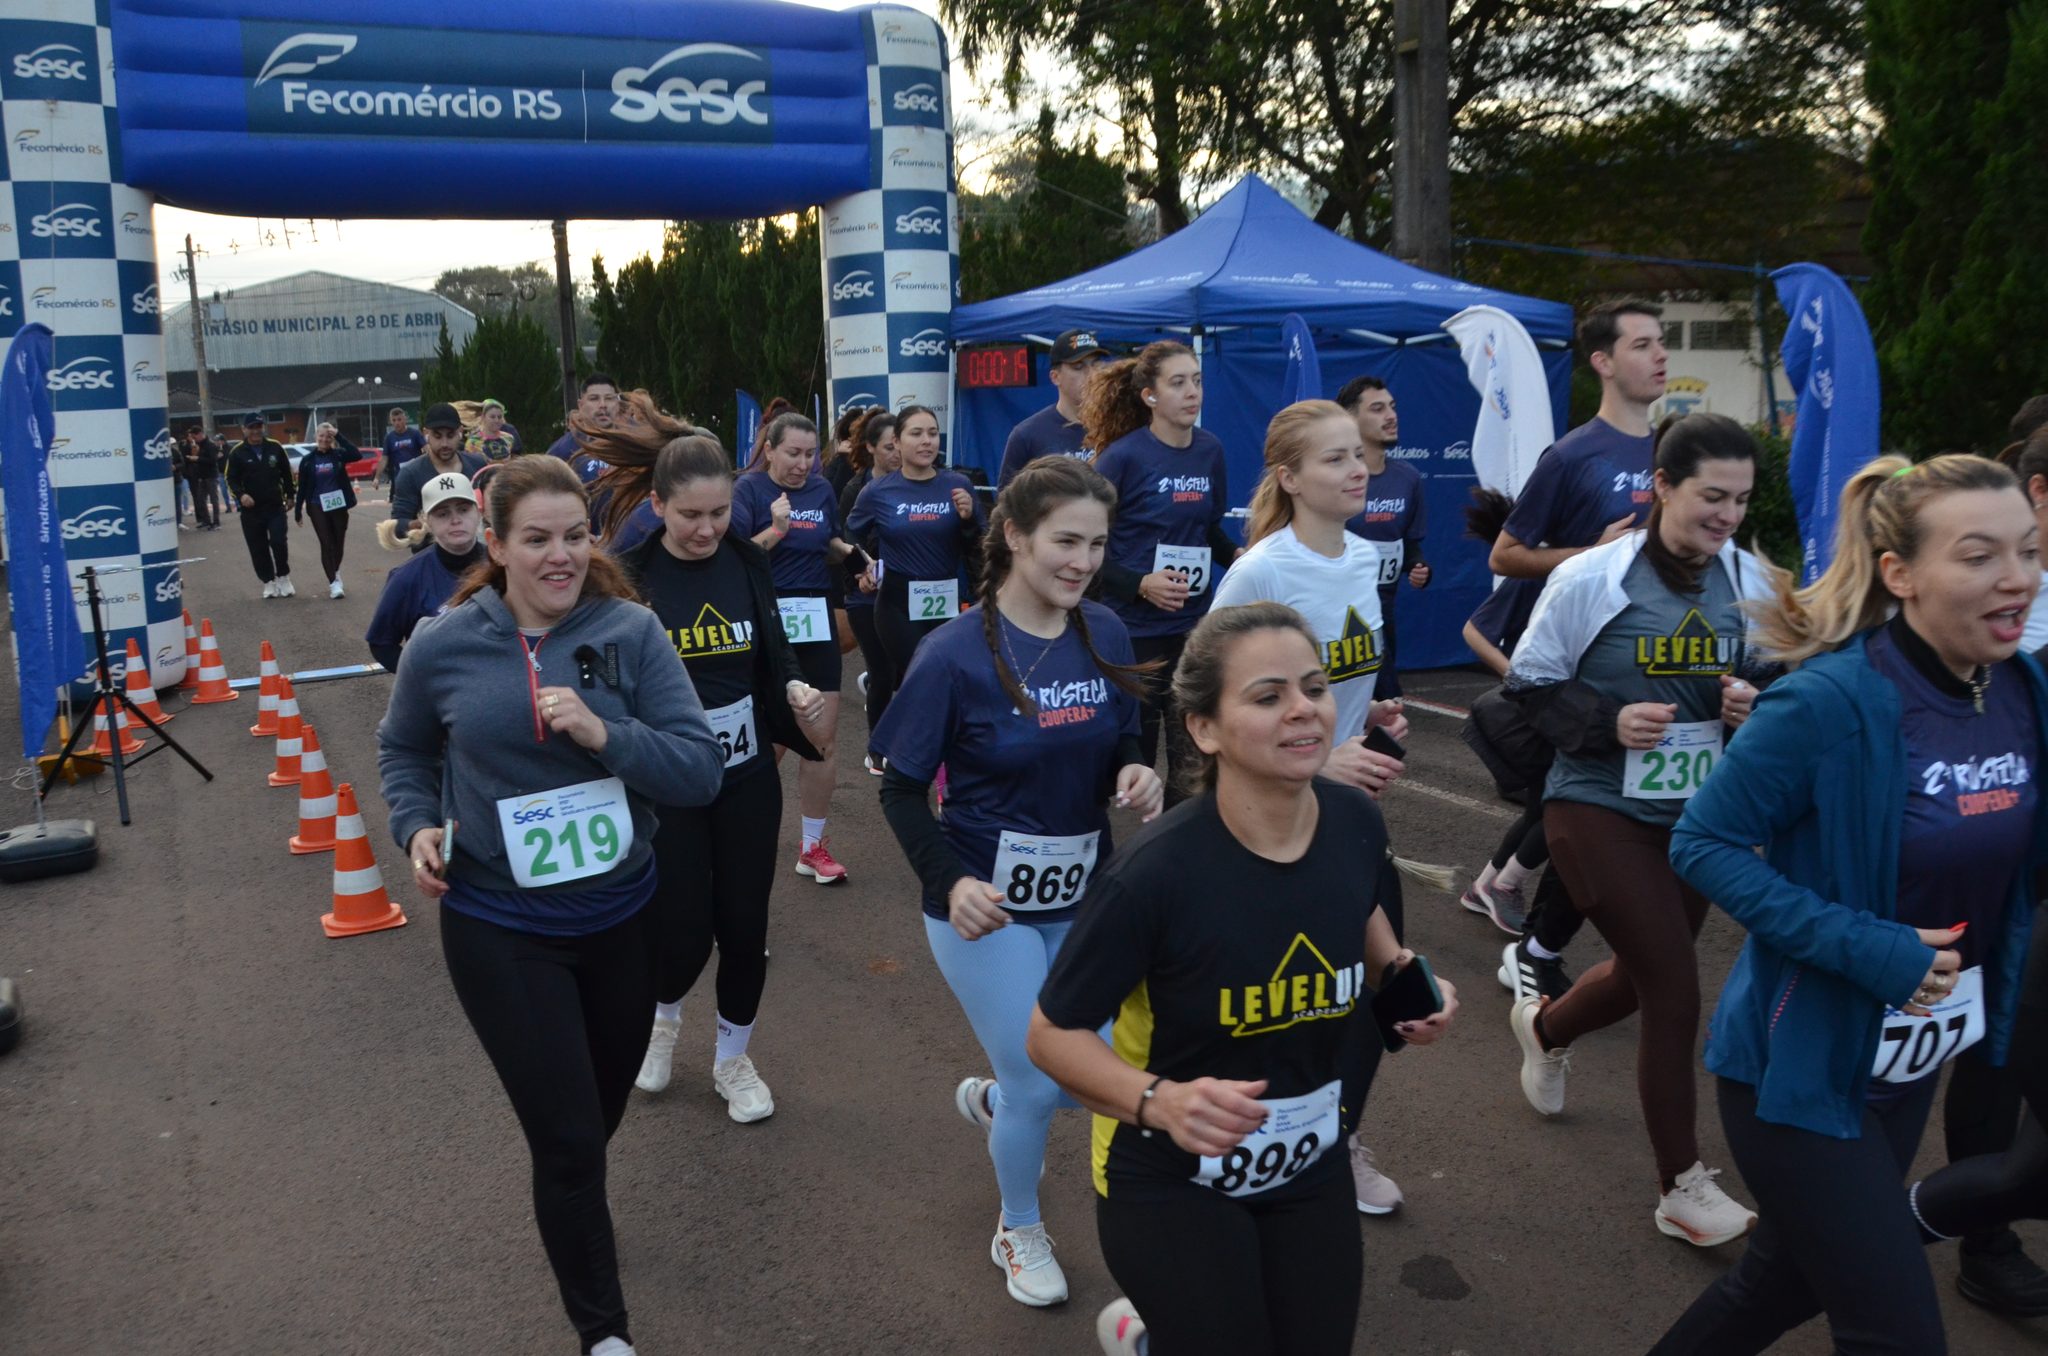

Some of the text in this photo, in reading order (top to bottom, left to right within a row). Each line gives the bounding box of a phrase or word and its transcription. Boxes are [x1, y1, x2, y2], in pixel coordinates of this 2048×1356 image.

[13, 54, 87, 81] Sesc
[282, 81, 562, 121] Fecomércio RS
[610, 66, 768, 125] Sesc
[893, 90, 938, 113] Sesc
[20, 143, 103, 155] Fecomércio RS
[31, 214, 102, 237] Sesc
[896, 214, 942, 235] Sesc
[833, 281, 874, 300] Sesc
[895, 282, 939, 291] Fecomércio
[36, 299, 116, 309] Fecomércio RS
[263, 316, 352, 334] MUNICIPAL
[355, 314, 377, 330] 29
[380, 313, 401, 328] DE
[900, 337, 946, 356] Sesc
[46, 369, 115, 391] Sesc
[51, 447, 128, 460] Fecomércio RS
[1383, 446, 1430, 459] ndicatos
[39, 470, 50, 543] Sindicatos
[325, 498, 343, 509] 240
[61, 518, 127, 540] Sesc
[127, 593, 141, 602] RS
[922, 595, 946, 617] 22
[785, 614, 812, 639] 51
[712, 643, 747, 652] ACADEMIA
[1637, 636, 1715, 664] LEVEL
[1038, 678, 1108, 709] RÚSTICA
[1038, 705, 1097, 728] COOPERA+
[1638, 749, 1712, 791] 230
[512, 806, 555, 825] Sesc
[524, 813, 619, 877] 219
[1007, 863, 1085, 905] 869
[1220, 972, 1330, 1026] LEVEL
[1878, 1012, 1967, 1079] 707
[1211, 1132, 1319, 1192] 898
